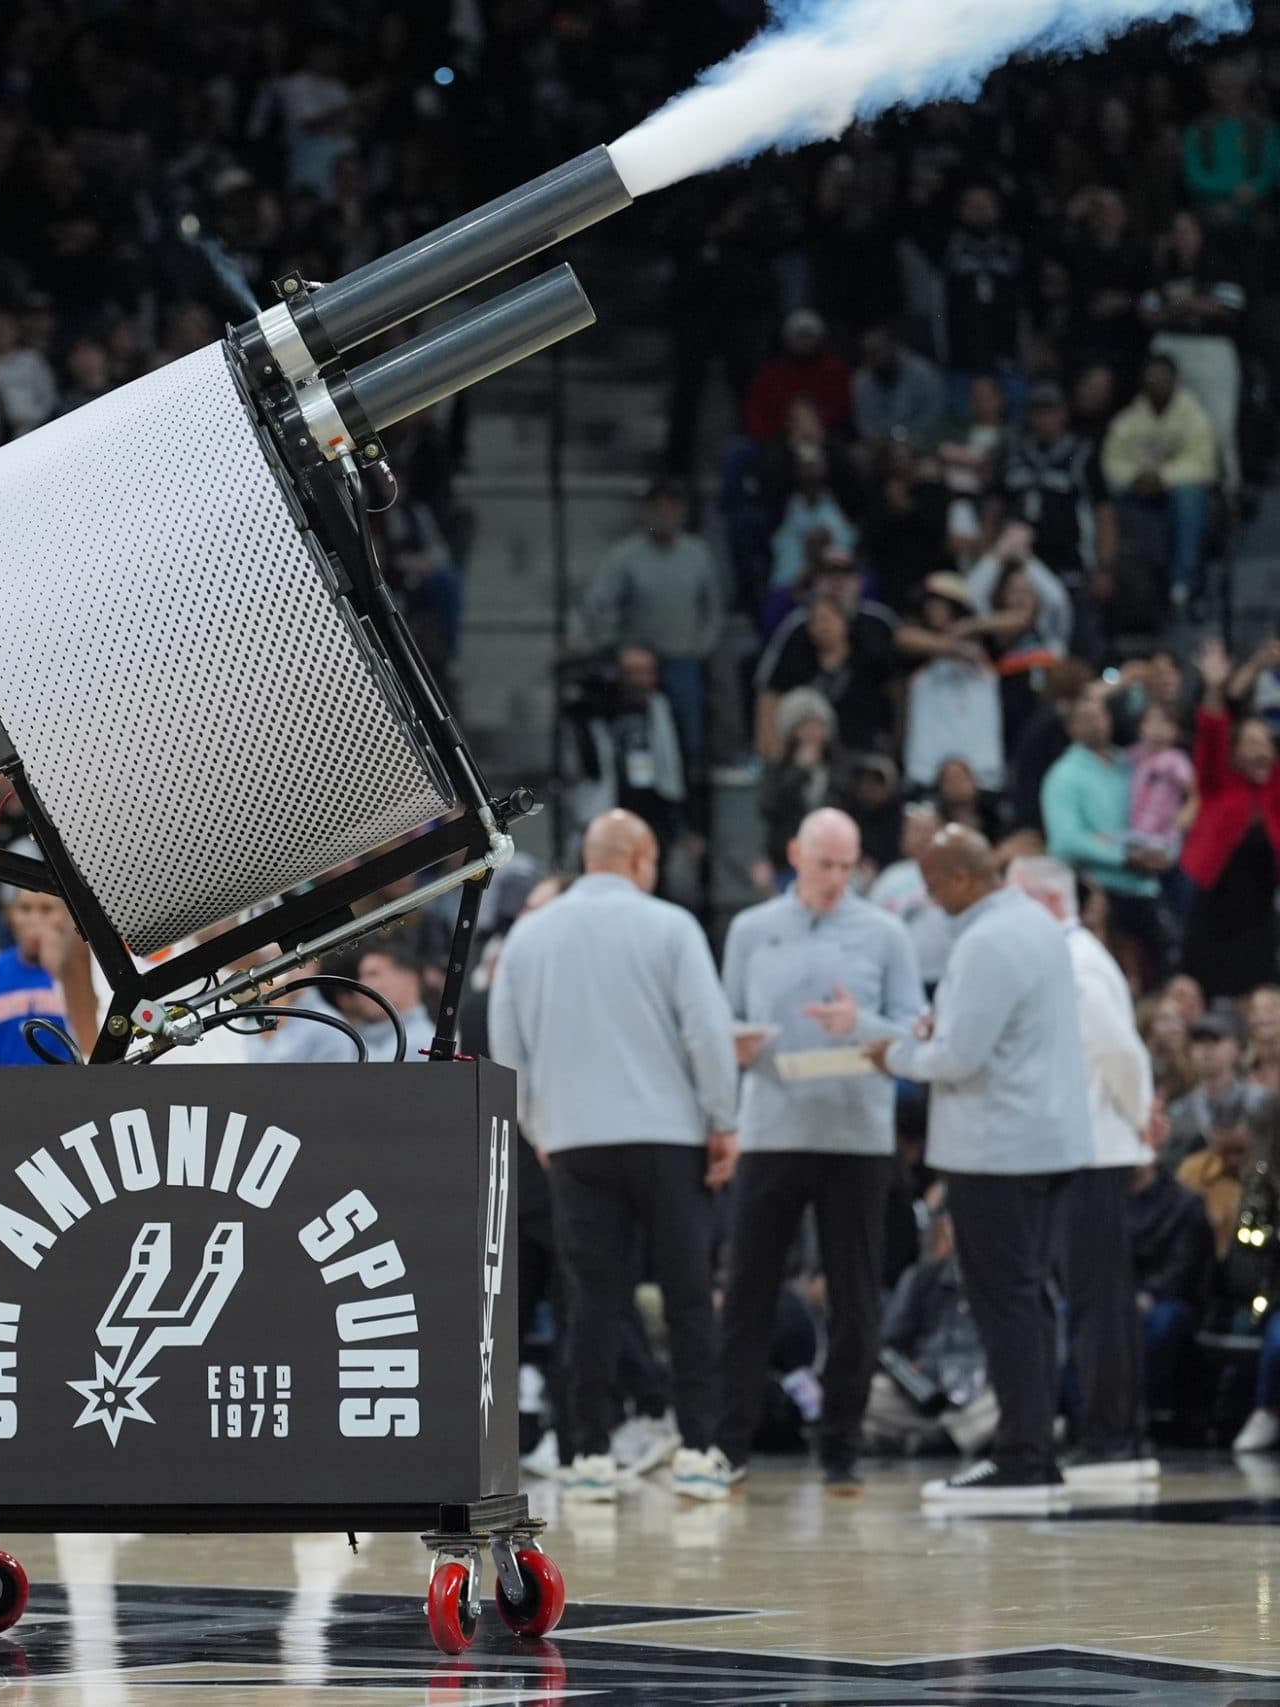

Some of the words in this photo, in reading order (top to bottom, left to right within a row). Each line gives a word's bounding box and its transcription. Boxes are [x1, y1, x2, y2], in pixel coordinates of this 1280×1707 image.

[298, 1189, 420, 1437] SPURS
[207, 1365, 292, 1400] ESTD
[210, 1403, 289, 1438] 1973
